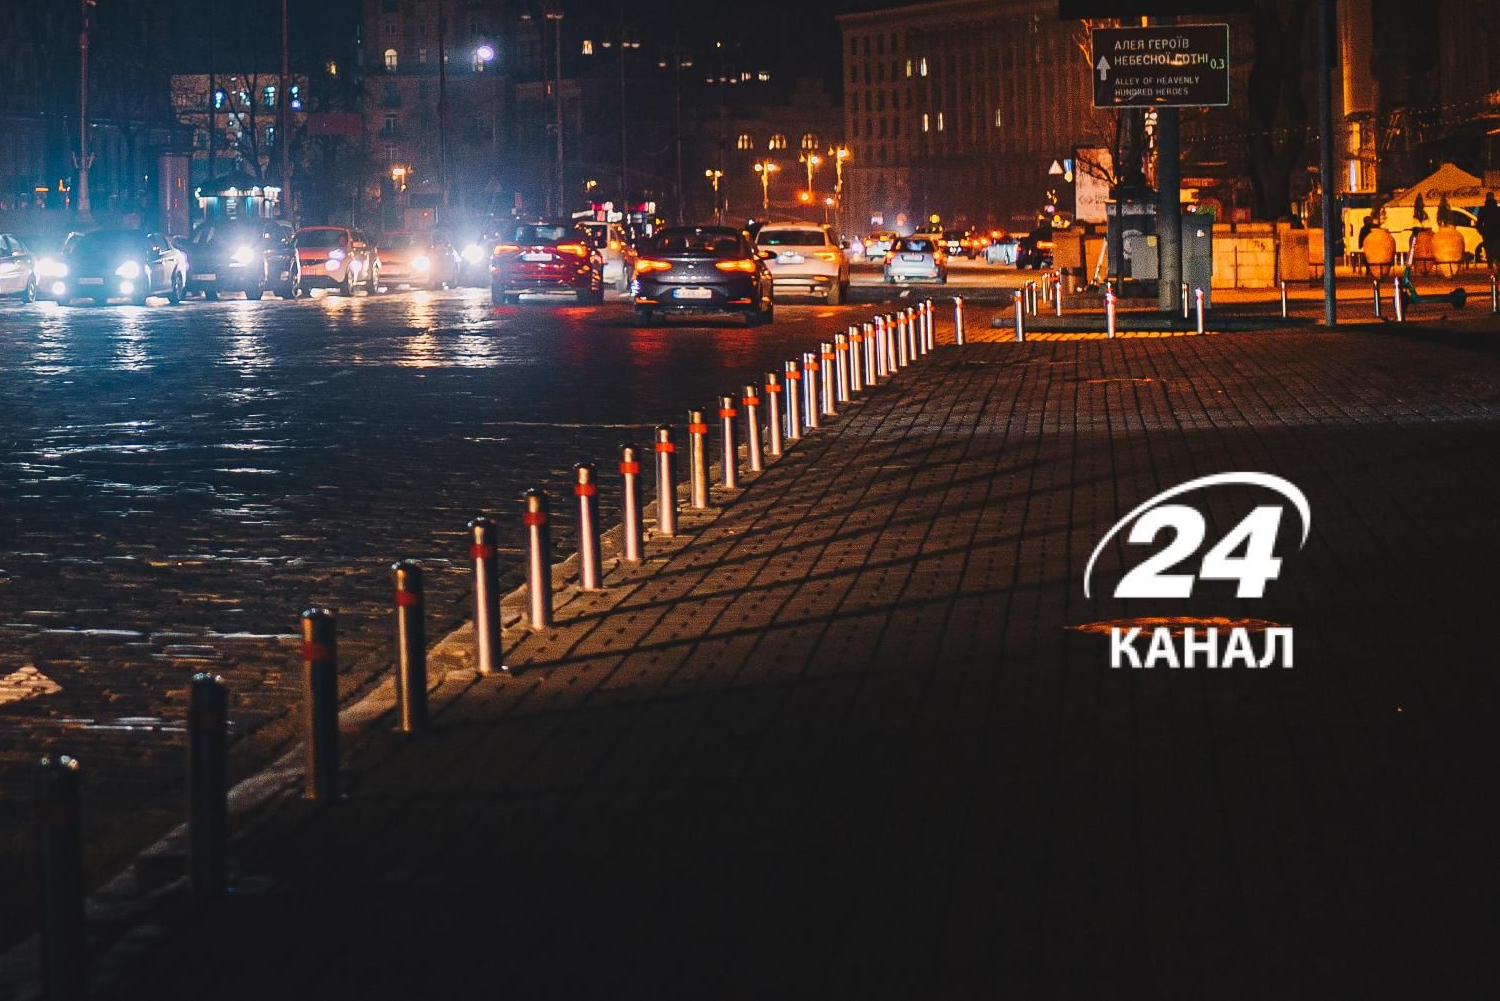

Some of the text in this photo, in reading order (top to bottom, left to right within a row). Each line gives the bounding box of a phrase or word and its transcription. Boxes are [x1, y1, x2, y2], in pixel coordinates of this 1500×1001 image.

[1114, 36, 1189, 50] АЛЕЯ ГЕРОЇВ
[1114, 52, 1209, 66] НЕБЕСНОЇ СОТНІ
[1115, 76, 1200, 86] ALLEY OF HEAVENLY
[1115, 87, 1189, 96] HUNDRED HEROES
